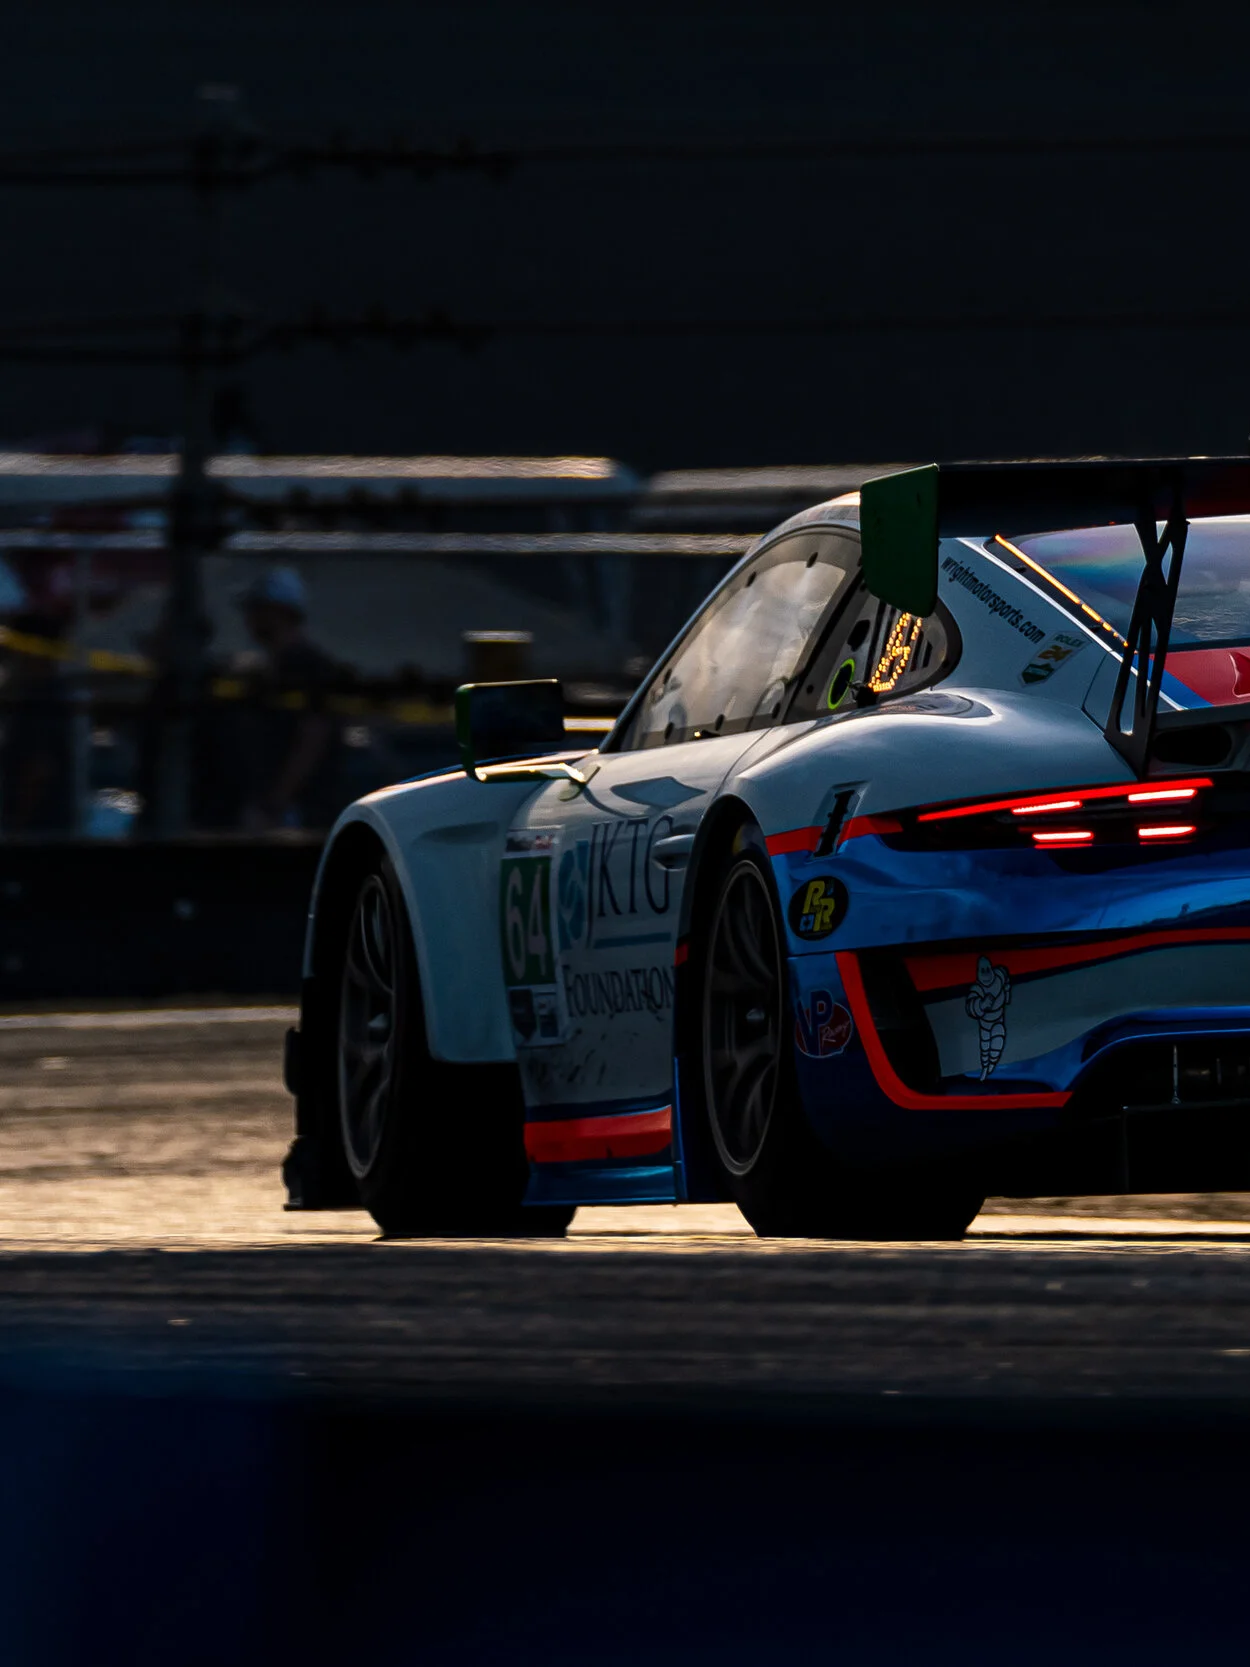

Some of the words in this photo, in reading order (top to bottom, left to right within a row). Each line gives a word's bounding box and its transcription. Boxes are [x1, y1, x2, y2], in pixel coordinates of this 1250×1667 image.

[941, 557, 1046, 644] wrightmotorsports.com
[1053, 634, 1086, 648] ROLEX
[505, 863, 548, 981] 64
[586, 814, 674, 949] JKTG
[563, 964, 674, 1018] FOUNDATION
